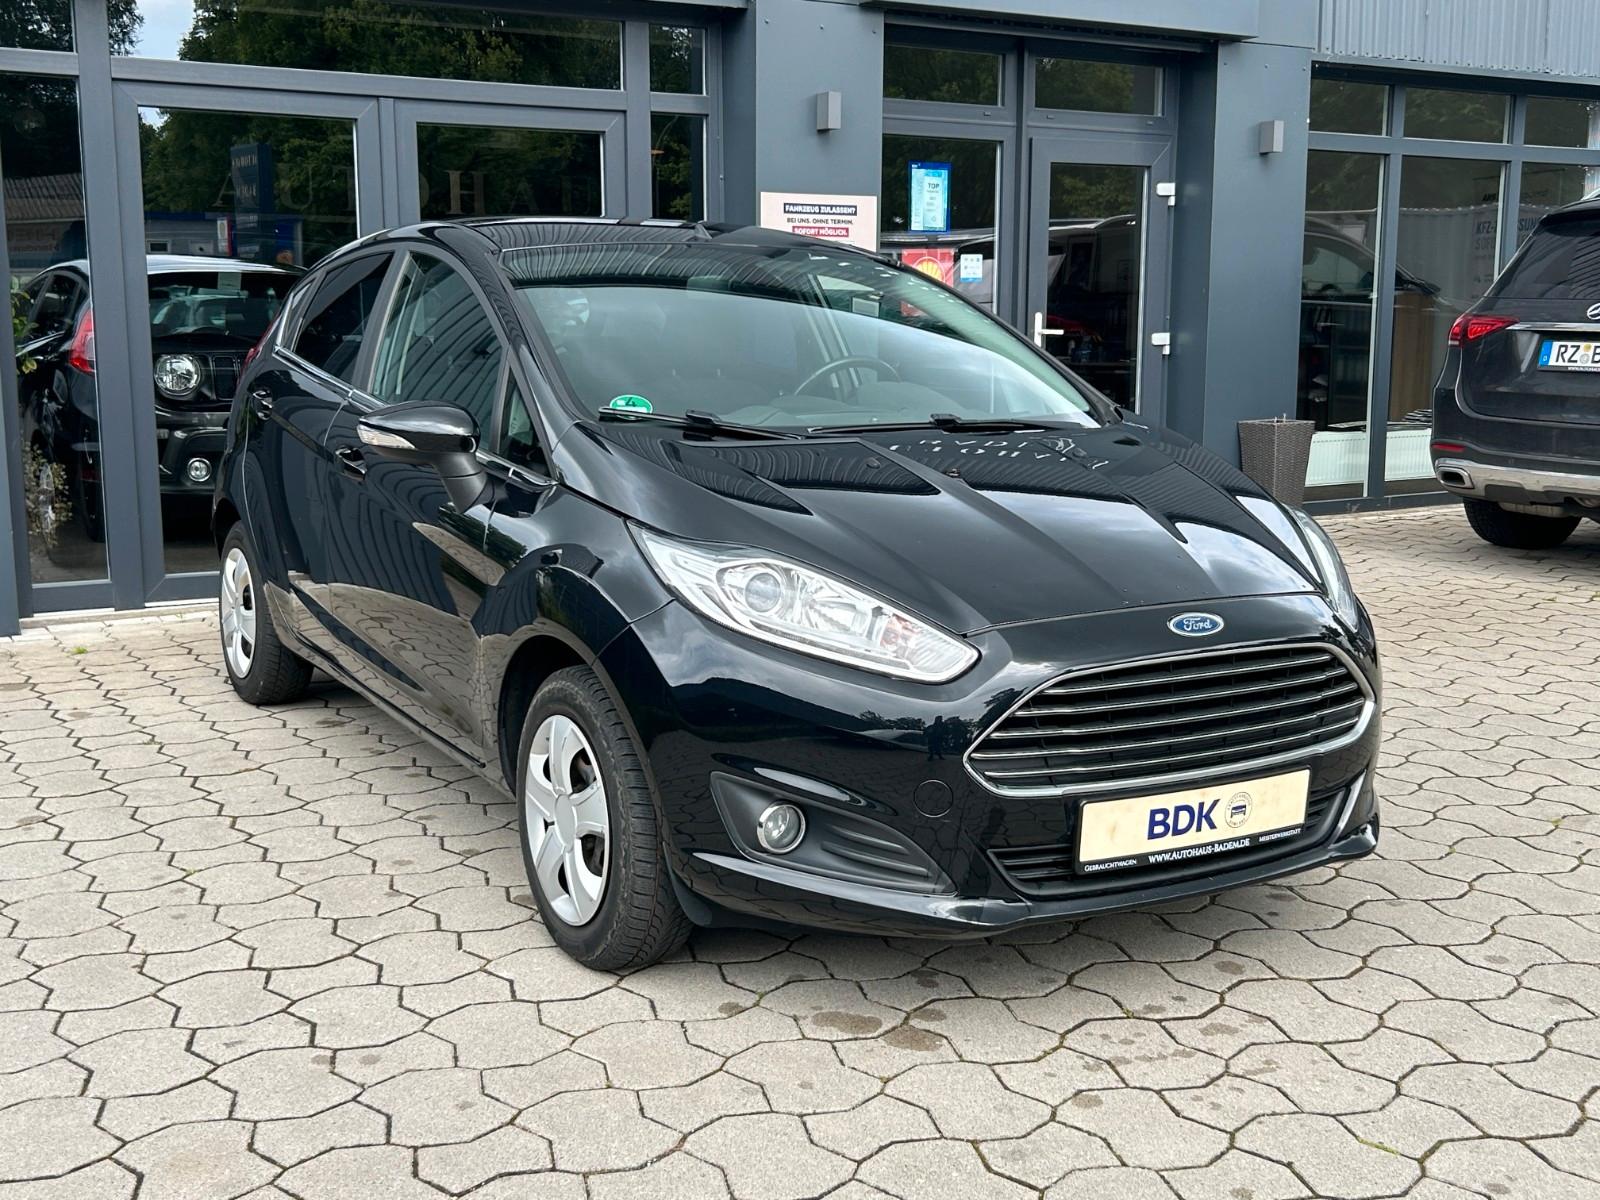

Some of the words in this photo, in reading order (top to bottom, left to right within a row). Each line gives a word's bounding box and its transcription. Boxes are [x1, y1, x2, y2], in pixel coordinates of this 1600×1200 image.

[927, 182, 940, 190] TOP
[785, 204, 819, 213] FAHRZEUG
[820, 205, 856, 215] ZULASSEN?
[794, 227, 818, 235] SOFORT
[819, 227, 847, 236] MÖGLICH.
[1555, 344, 1580, 364] RZ
[625, 397, 637, 407] 4
[1183, 617, 1212, 631] Ford
[1147, 799, 1220, 840] BDK
